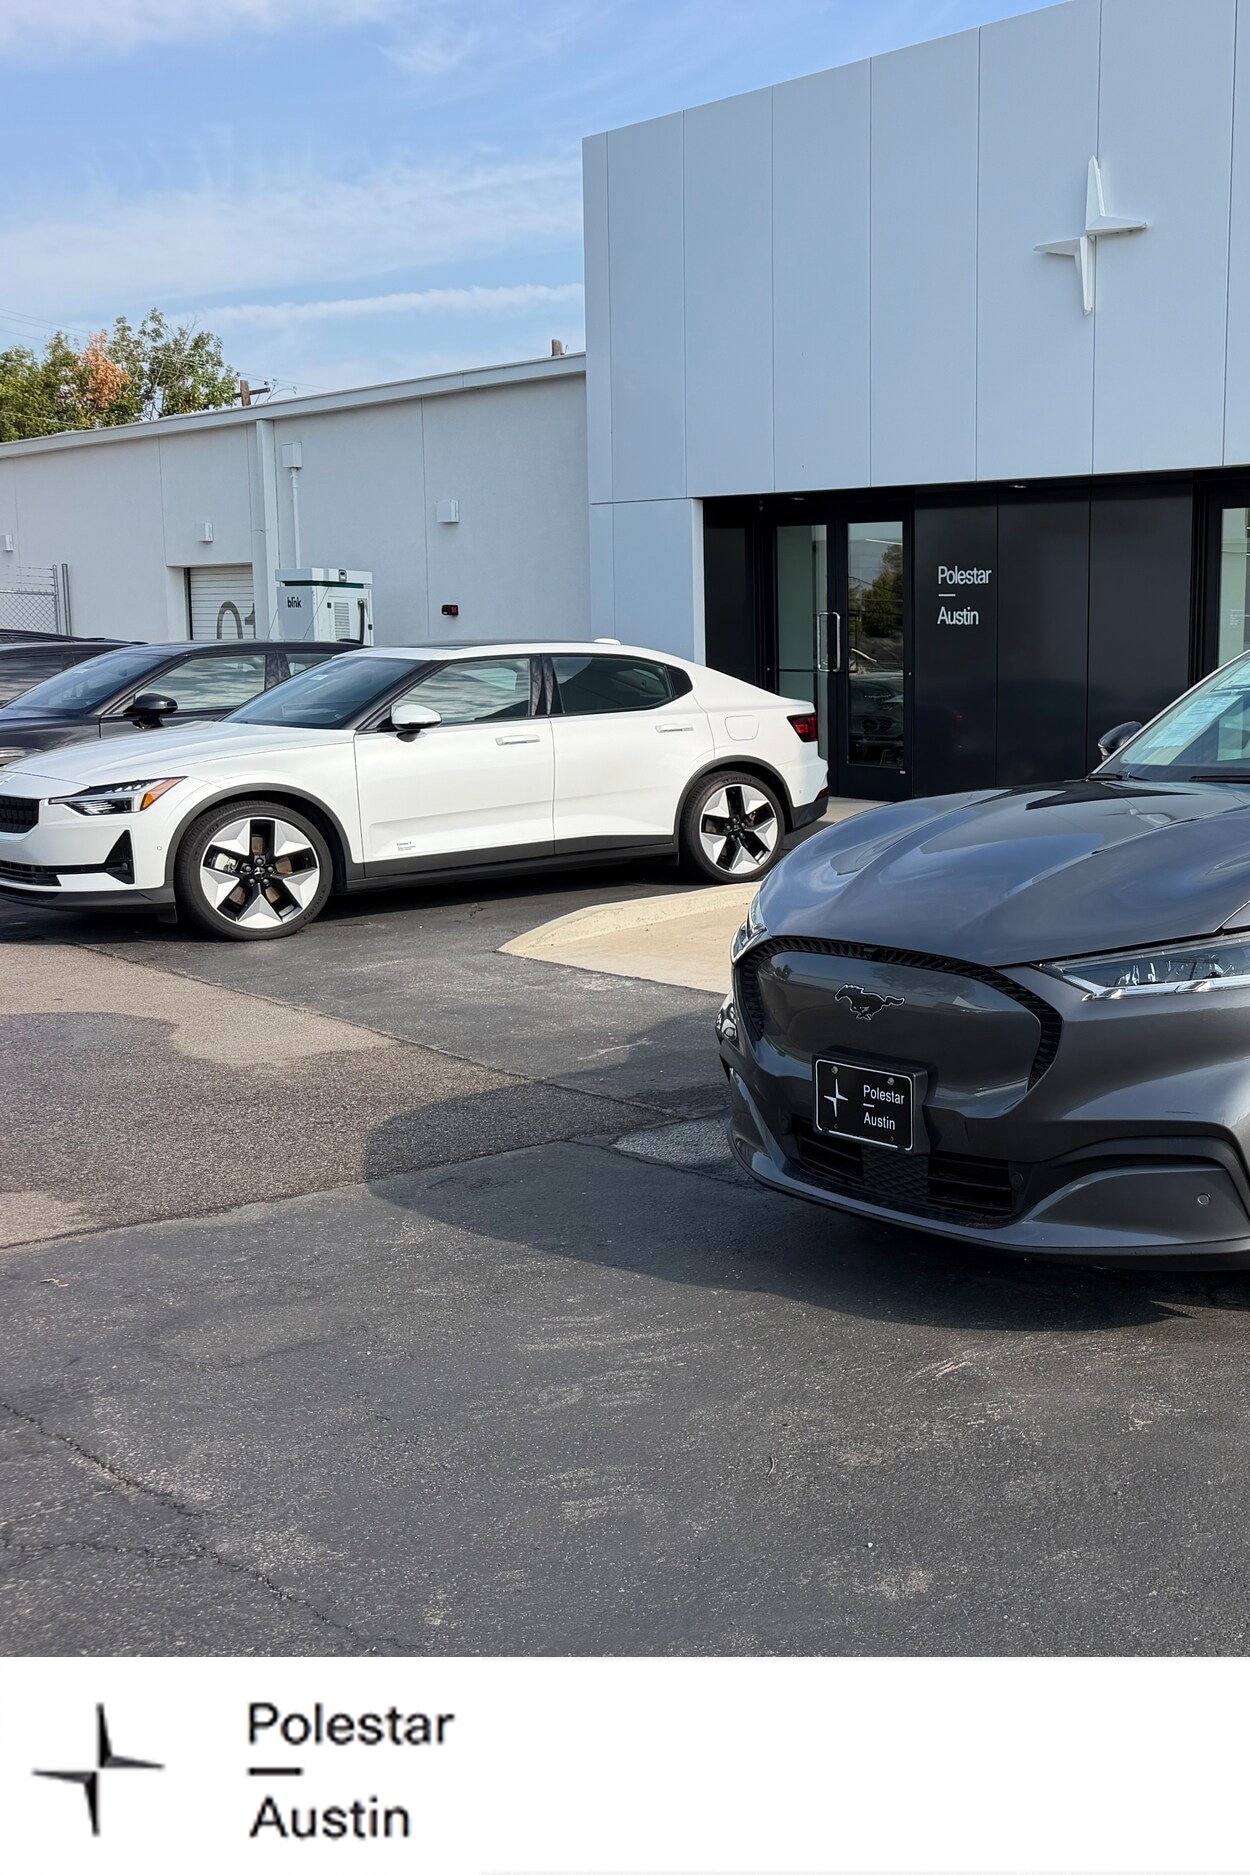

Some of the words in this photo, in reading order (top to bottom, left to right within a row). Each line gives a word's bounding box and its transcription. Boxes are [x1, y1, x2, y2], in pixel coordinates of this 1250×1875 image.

[938, 565, 992, 585] Polestar
[937, 606, 979, 625] Austin
[863, 1084, 905, 1105] Polestar
[863, 1111, 896, 1130] Austin
